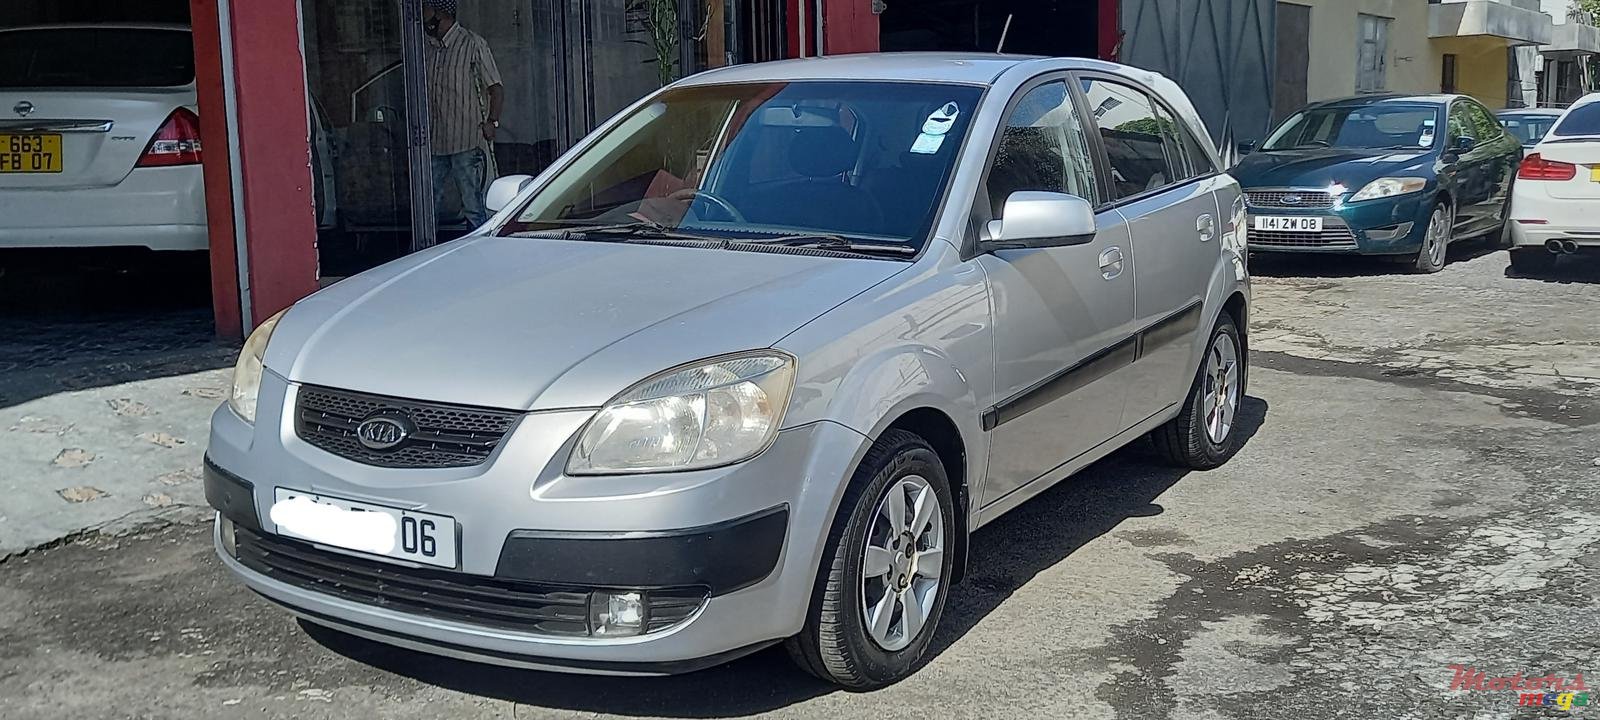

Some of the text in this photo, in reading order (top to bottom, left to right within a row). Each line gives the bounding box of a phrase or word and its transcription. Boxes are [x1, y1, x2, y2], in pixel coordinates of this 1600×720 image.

[10, 136, 42, 152] 663
[0, 153, 52, 170] FB 07
[1262, 218, 1316, 229] 1141 ZW 08
[364, 422, 396, 442] KIA
[401, 516, 436, 557] 06
